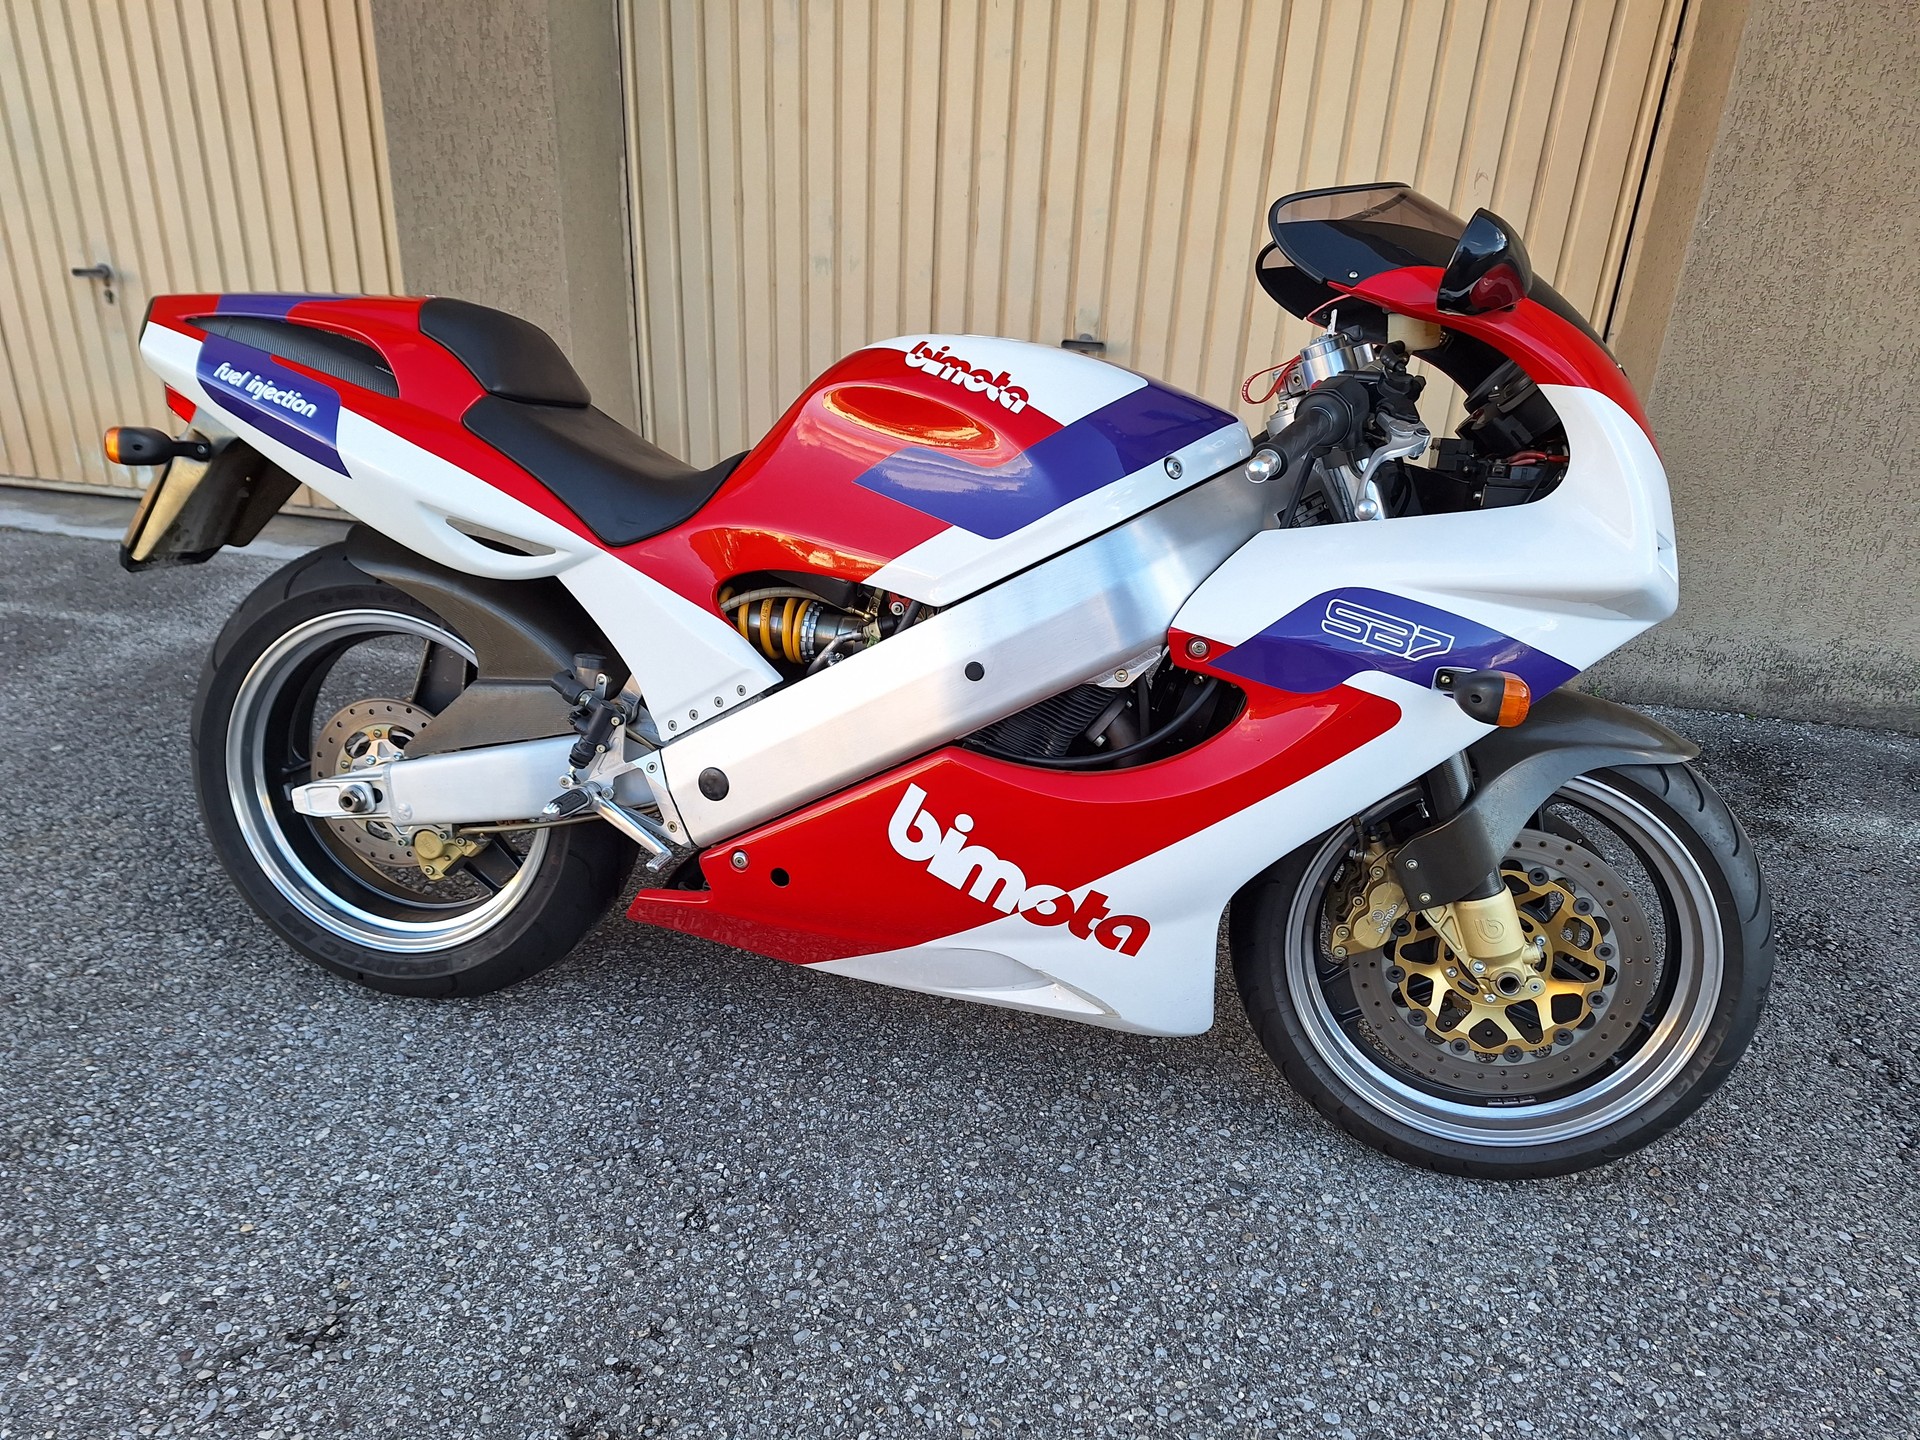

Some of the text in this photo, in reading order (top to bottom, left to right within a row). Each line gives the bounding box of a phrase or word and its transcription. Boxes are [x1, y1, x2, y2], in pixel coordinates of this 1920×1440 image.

[213, 362, 318, 418] fuel injection
[905, 341, 1030, 415] bimota
[1321, 598, 1456, 662] SB7
[888, 782, 1151, 957] bimota
